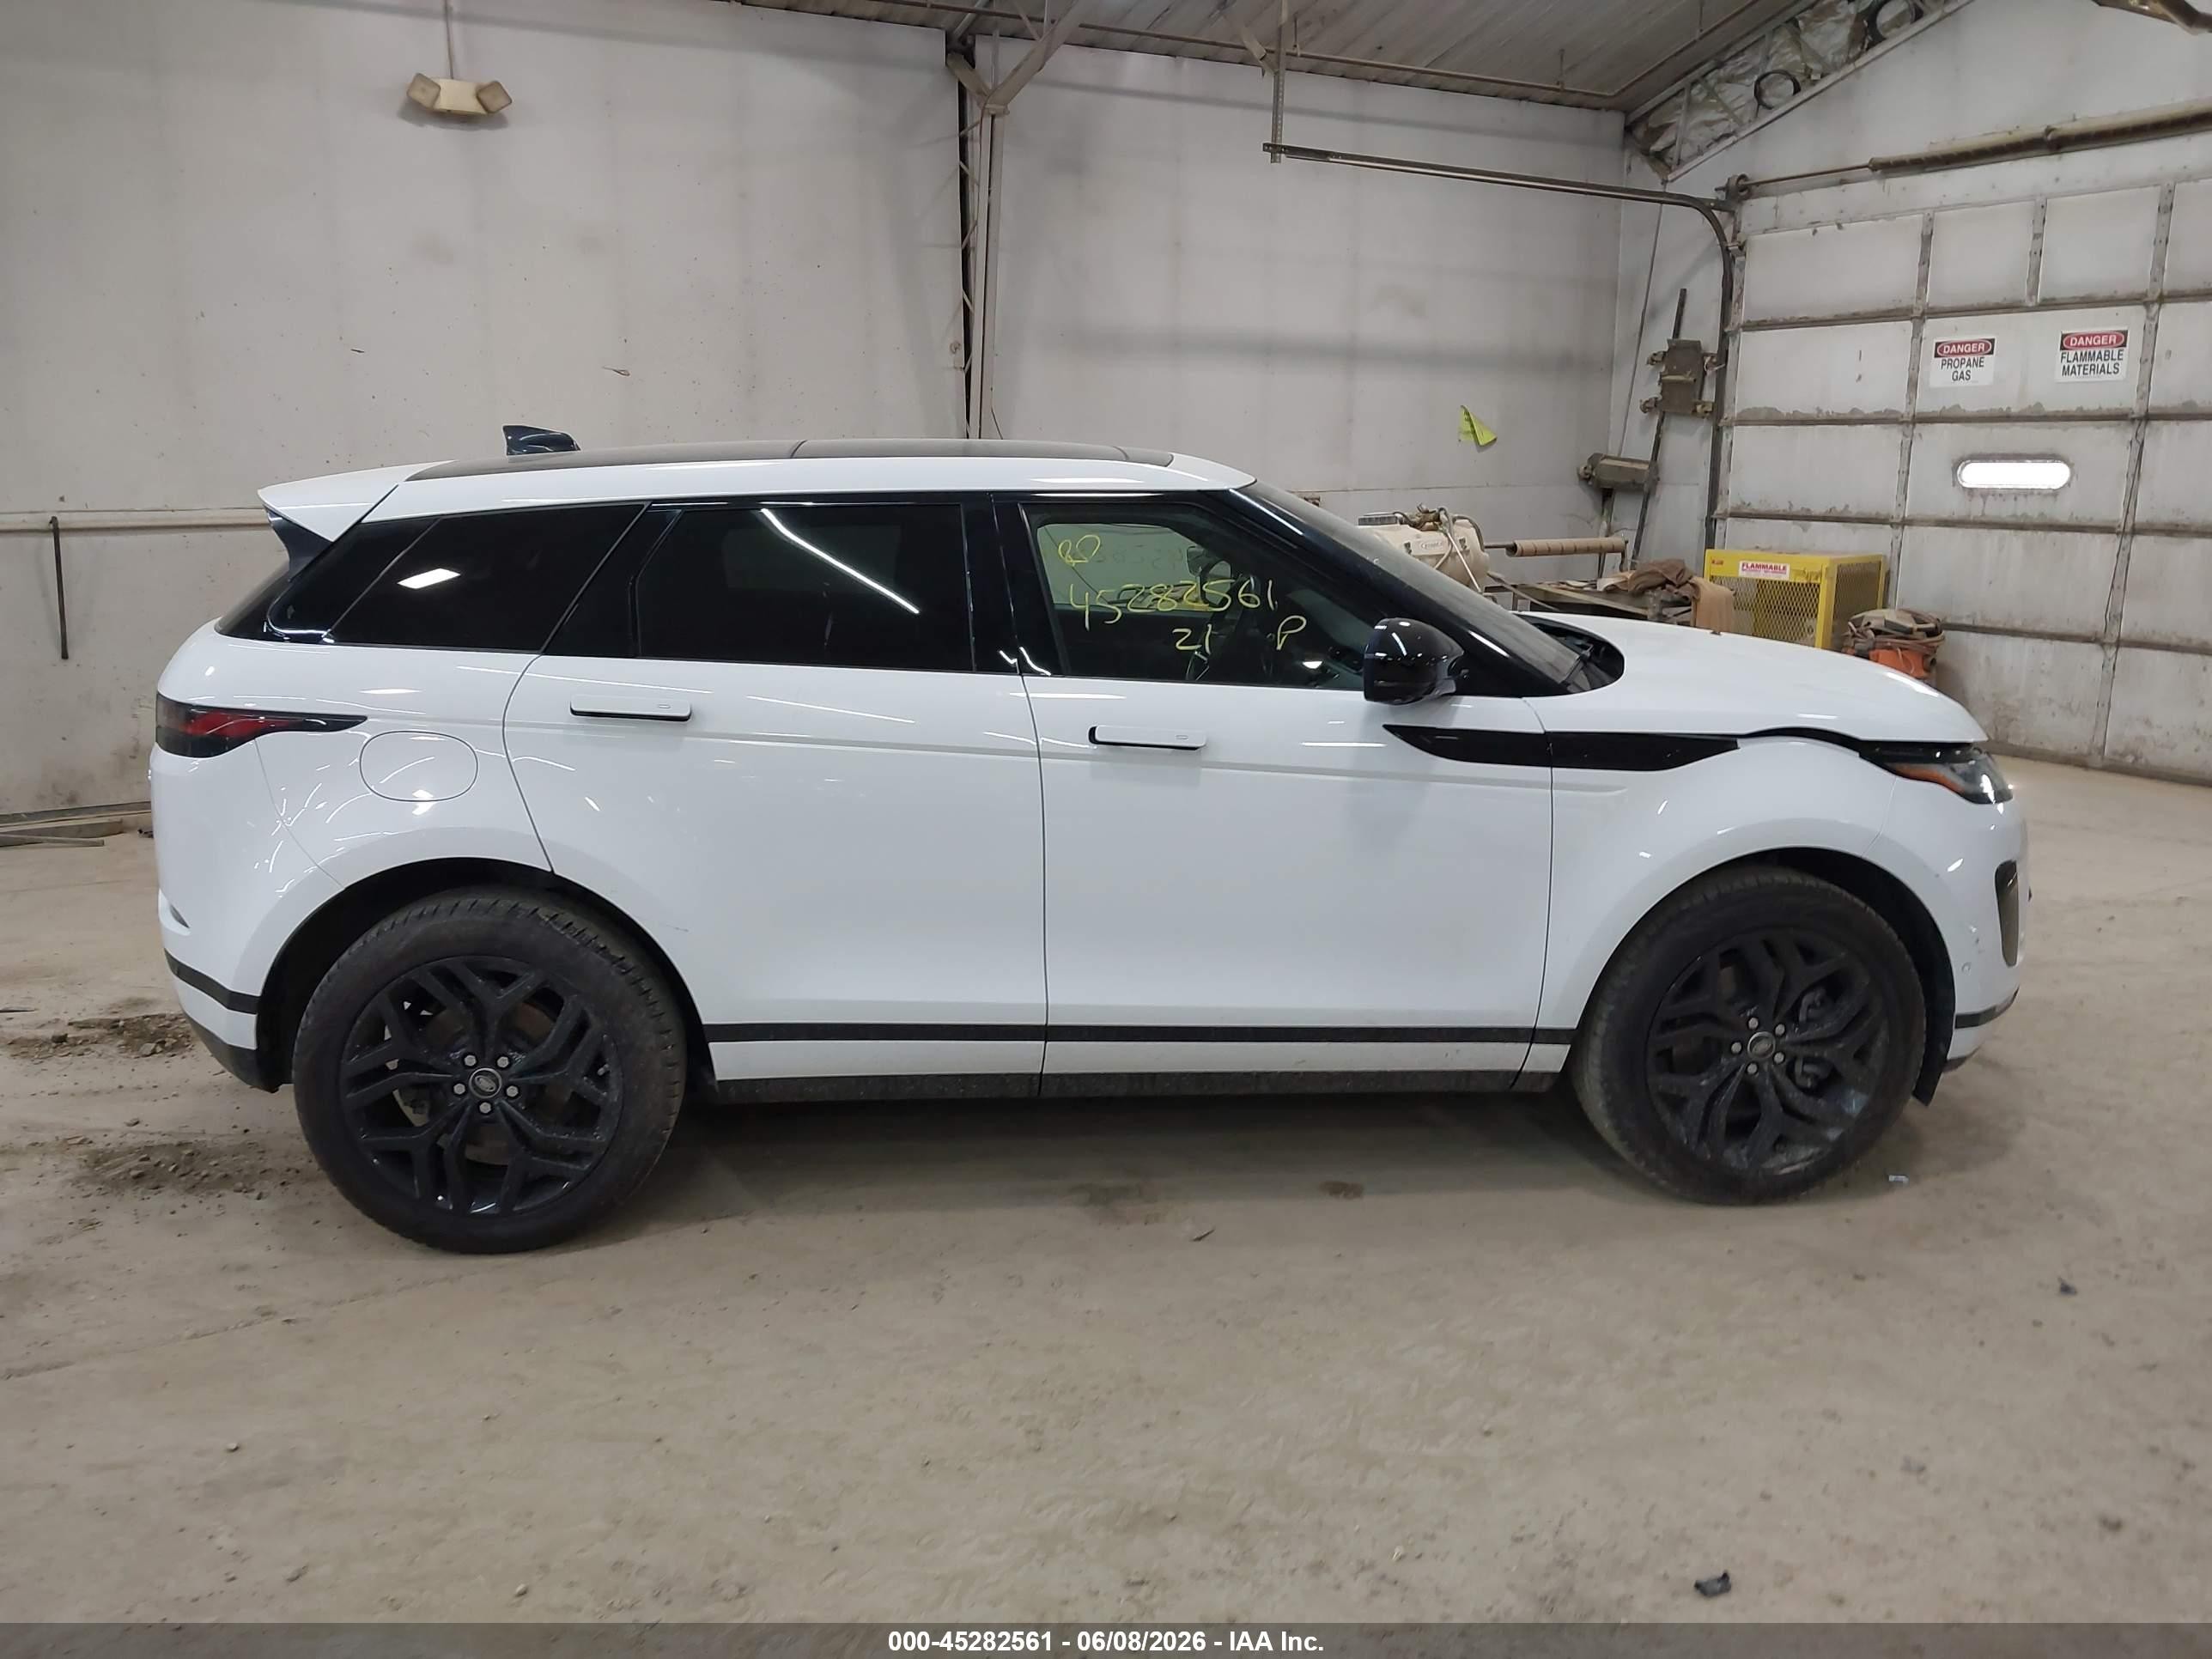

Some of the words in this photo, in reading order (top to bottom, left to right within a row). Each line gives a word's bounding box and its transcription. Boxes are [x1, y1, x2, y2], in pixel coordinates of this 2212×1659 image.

[2069, 333, 2117, 347] DANGER
[1943, 342, 1985, 355] DANGER
[1941, 356, 1984, 369] PROPANE
[2060, 349, 2124, 363] FLAMMABLE
[1951, 369, 1972, 381] GAS
[2062, 362, 2120, 377] MATERIALS
[1741, 562, 1787, 572] FLAMMABLE
